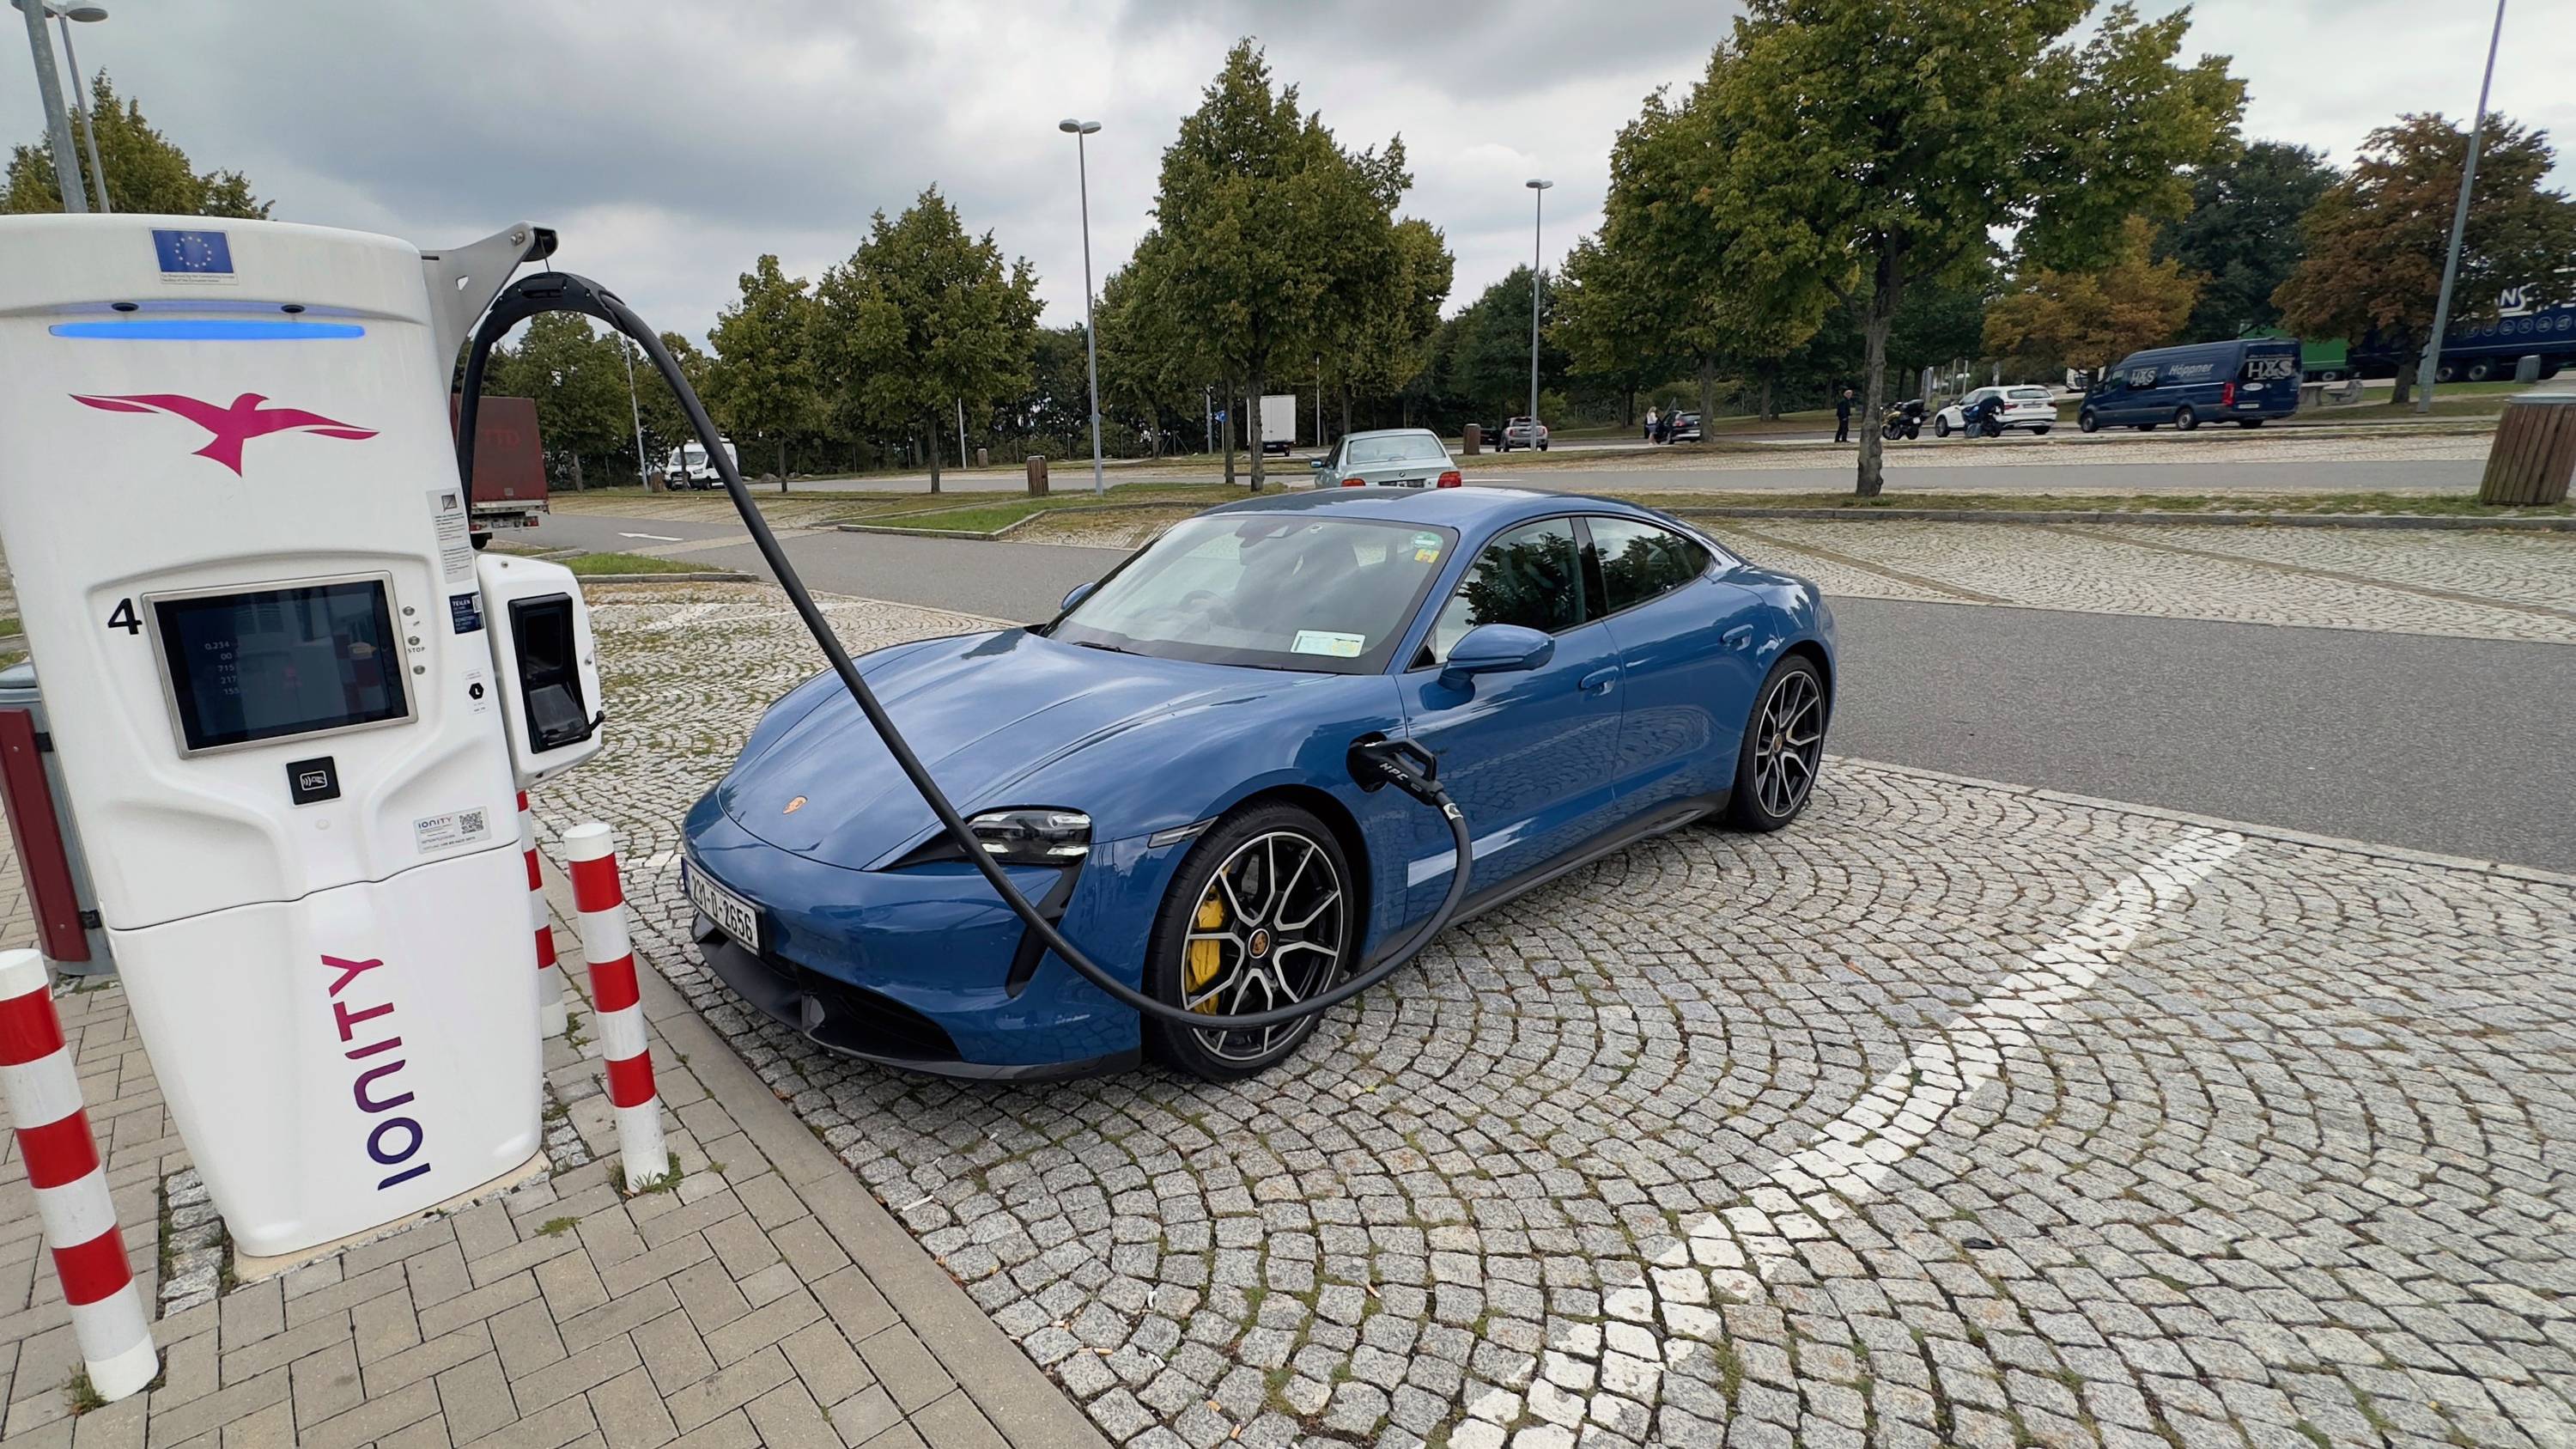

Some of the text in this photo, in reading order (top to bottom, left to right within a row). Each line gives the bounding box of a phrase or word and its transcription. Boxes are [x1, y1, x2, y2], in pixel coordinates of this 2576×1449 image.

[2129, 368, 2157, 387] H&S
[2247, 358, 2293, 380] H&S
[107, 598, 143, 635] 4
[1379, 763, 1408, 780] HPC
[418, 817, 453, 829] IONITY
[321, 954, 431, 1190] IONITY
